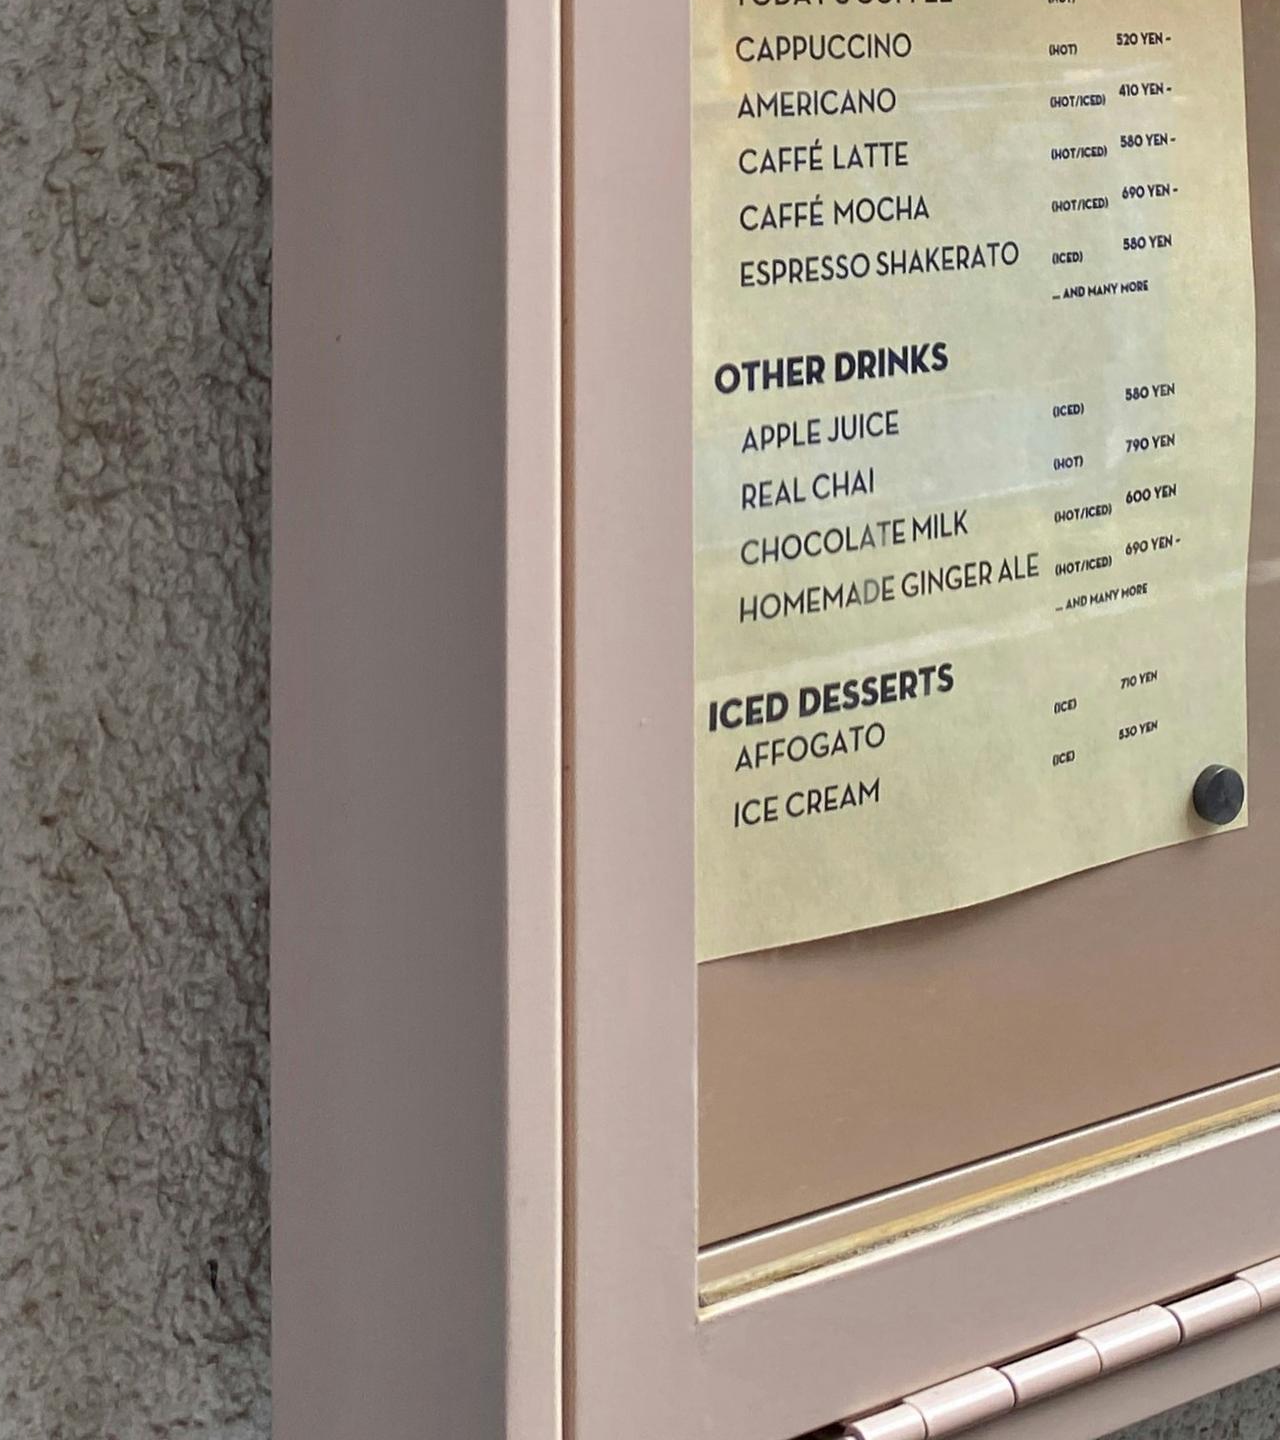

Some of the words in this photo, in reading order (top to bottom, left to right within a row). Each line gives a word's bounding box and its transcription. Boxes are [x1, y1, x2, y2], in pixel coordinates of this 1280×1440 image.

[736, 33, 912, 62] CAPPUCCINO
[1049, 44, 1078, 56] (HOT)
[1116, 33, 1139, 46] 520
[1141, 33, 1162, 45] YEN
[737, 87, 896, 119] AMERICANO
[1050, 94, 1106, 108] (HOT/ICED)
[1119, 84, 1140, 96] 410
[1142, 83, 1163, 96] YEN
[739, 138, 823, 174] CAFFÉ
[832, 141, 909, 170] LATTE
[1051, 144, 1108, 160] (HOT/ICED)
[1120, 135, 1143, 148] 580
[1145, 133, 1168, 146] YEN
[740, 194, 824, 231] CAFFÉ
[834, 196, 929, 224] MOCHA
[1052, 197, 1109, 212] (HOT/ICED)
[1122, 186, 1145, 200] 690
[1147, 184, 1170, 198] YEN
[741, 254, 870, 288] ESPRESSO
[876, 242, 1020, 277] SHAKERATO
[1052, 250, 1083, 265] (ICED)
[1123, 236, 1146, 250] 580
[1148, 235, 1172, 248] YEN
[1063, 286, 1086, 300] AND
[1088, 282, 1118, 298] MANY
[1121, 280, 1149, 294] MORE
[714, 353, 826, 394] OTHER
[835, 342, 949, 382] DRINKS
[742, 419, 820, 453] APPLE
[827, 410, 899, 443] JUICE
[1053, 403, 1084, 417] (ICED)
[1125, 386, 1148, 401] 580
[1150, 383, 1175, 398] YEN
[742, 478, 806, 511] REAL
[812, 469, 875, 500] CHAI
[1053, 456, 1083, 470] (HOT)
[1126, 437, 1149, 452] 790
[1150, 434, 1175, 448] YEN
[741, 518, 906, 566] CHOCOLATE
[912, 510, 969, 541] MILK
[1054, 504, 1112, 523] (HOT/ICED)
[1126, 488, 1150, 504] 600
[1153, 485, 1176, 500] YEN
[739, 575, 895, 623] HOMEMADE
[901, 560, 993, 599] GINGER
[998, 553, 1039, 584] ALE
[1055, 556, 1112, 576] (HOT/ICED)
[1125, 540, 1149, 556] 690
[1151, 536, 1173, 552] YEN
[1065, 597, 1087, 611] AND
[1088, 589, 1120, 607] MANY
[1121, 584, 1147, 599] MORE
[708, 690, 788, 732] ICED
[799, 663, 954, 718] DESSERTS
[734, 723, 885, 772] AFFOGATO
[1054, 698, 1077, 714] (ICE)
[1120, 675, 1138, 689] 710
[1139, 671, 1157, 684] YEN
[733, 795, 778, 829] ICE
[785, 779, 881, 819] CREAM
[1053, 751, 1075, 766] (ICE)
[1139, 721, 1158, 735] YEN
